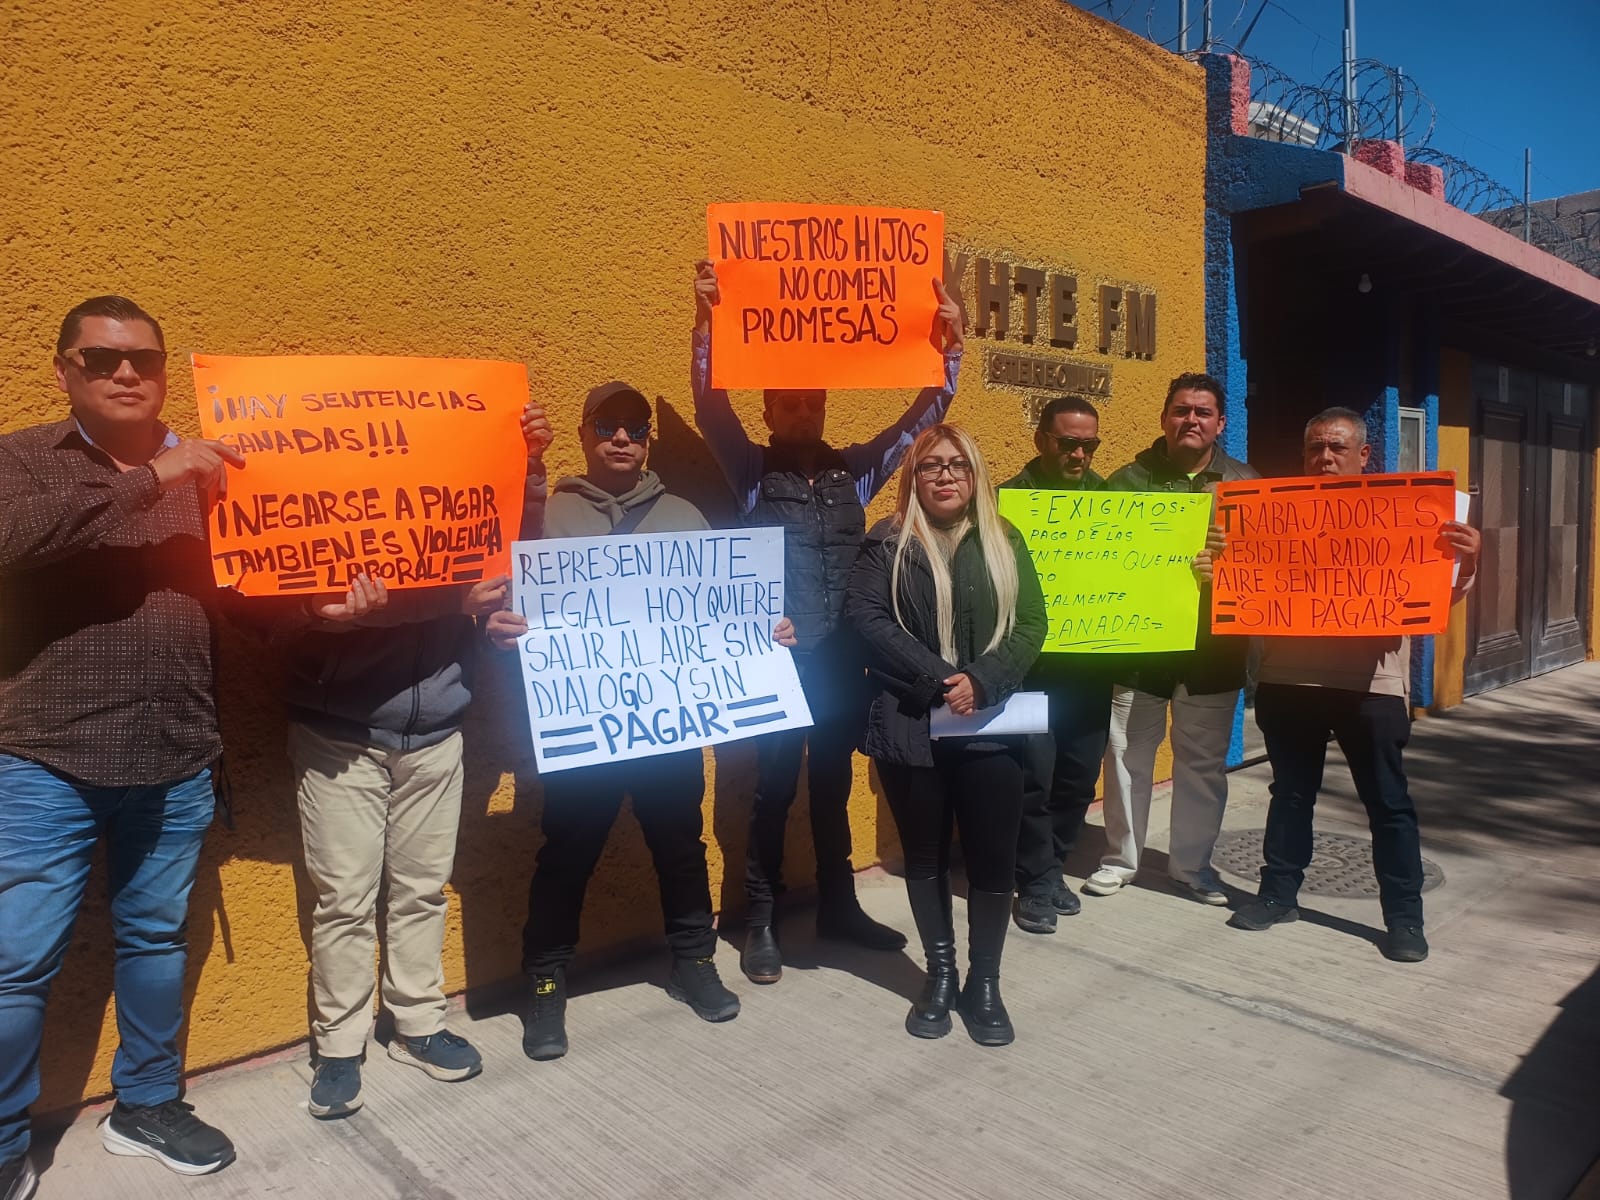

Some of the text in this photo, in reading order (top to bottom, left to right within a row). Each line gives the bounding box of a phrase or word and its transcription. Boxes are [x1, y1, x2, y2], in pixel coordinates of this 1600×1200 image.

[718, 215, 929, 265] NUESTROS HIJOS
[779, 265, 896, 302] NO COMEN
[742, 303, 898, 345] PROMESAS
[1099, 285, 1156, 359] FM
[301, 390, 486, 412] SENTENCIAS
[395, 487, 415, 521] A
[419, 485, 498, 521] PAGAR
[360, 527, 404, 558] ES
[408, 516, 502, 558] VIOLENCIA
[1030, 529, 1133, 541] PAGO DE LAS
[1401, 535, 1439, 564] AL
[519, 537, 756, 585] REPRESENTANTE
[1028, 548, 1118, 563] ENTENCIAS
[1123, 550, 1162, 570] QUE
[1216, 567, 1411, 598] AIRE SENTENCIAS
[520, 581, 781, 630] LEGAL HOY QUIERE
[525, 619, 774, 672] SALIR AL AIRE SIN
[532, 661, 747, 718] DIALOGO Y SIN
[599, 702, 729, 755] PAGAR
